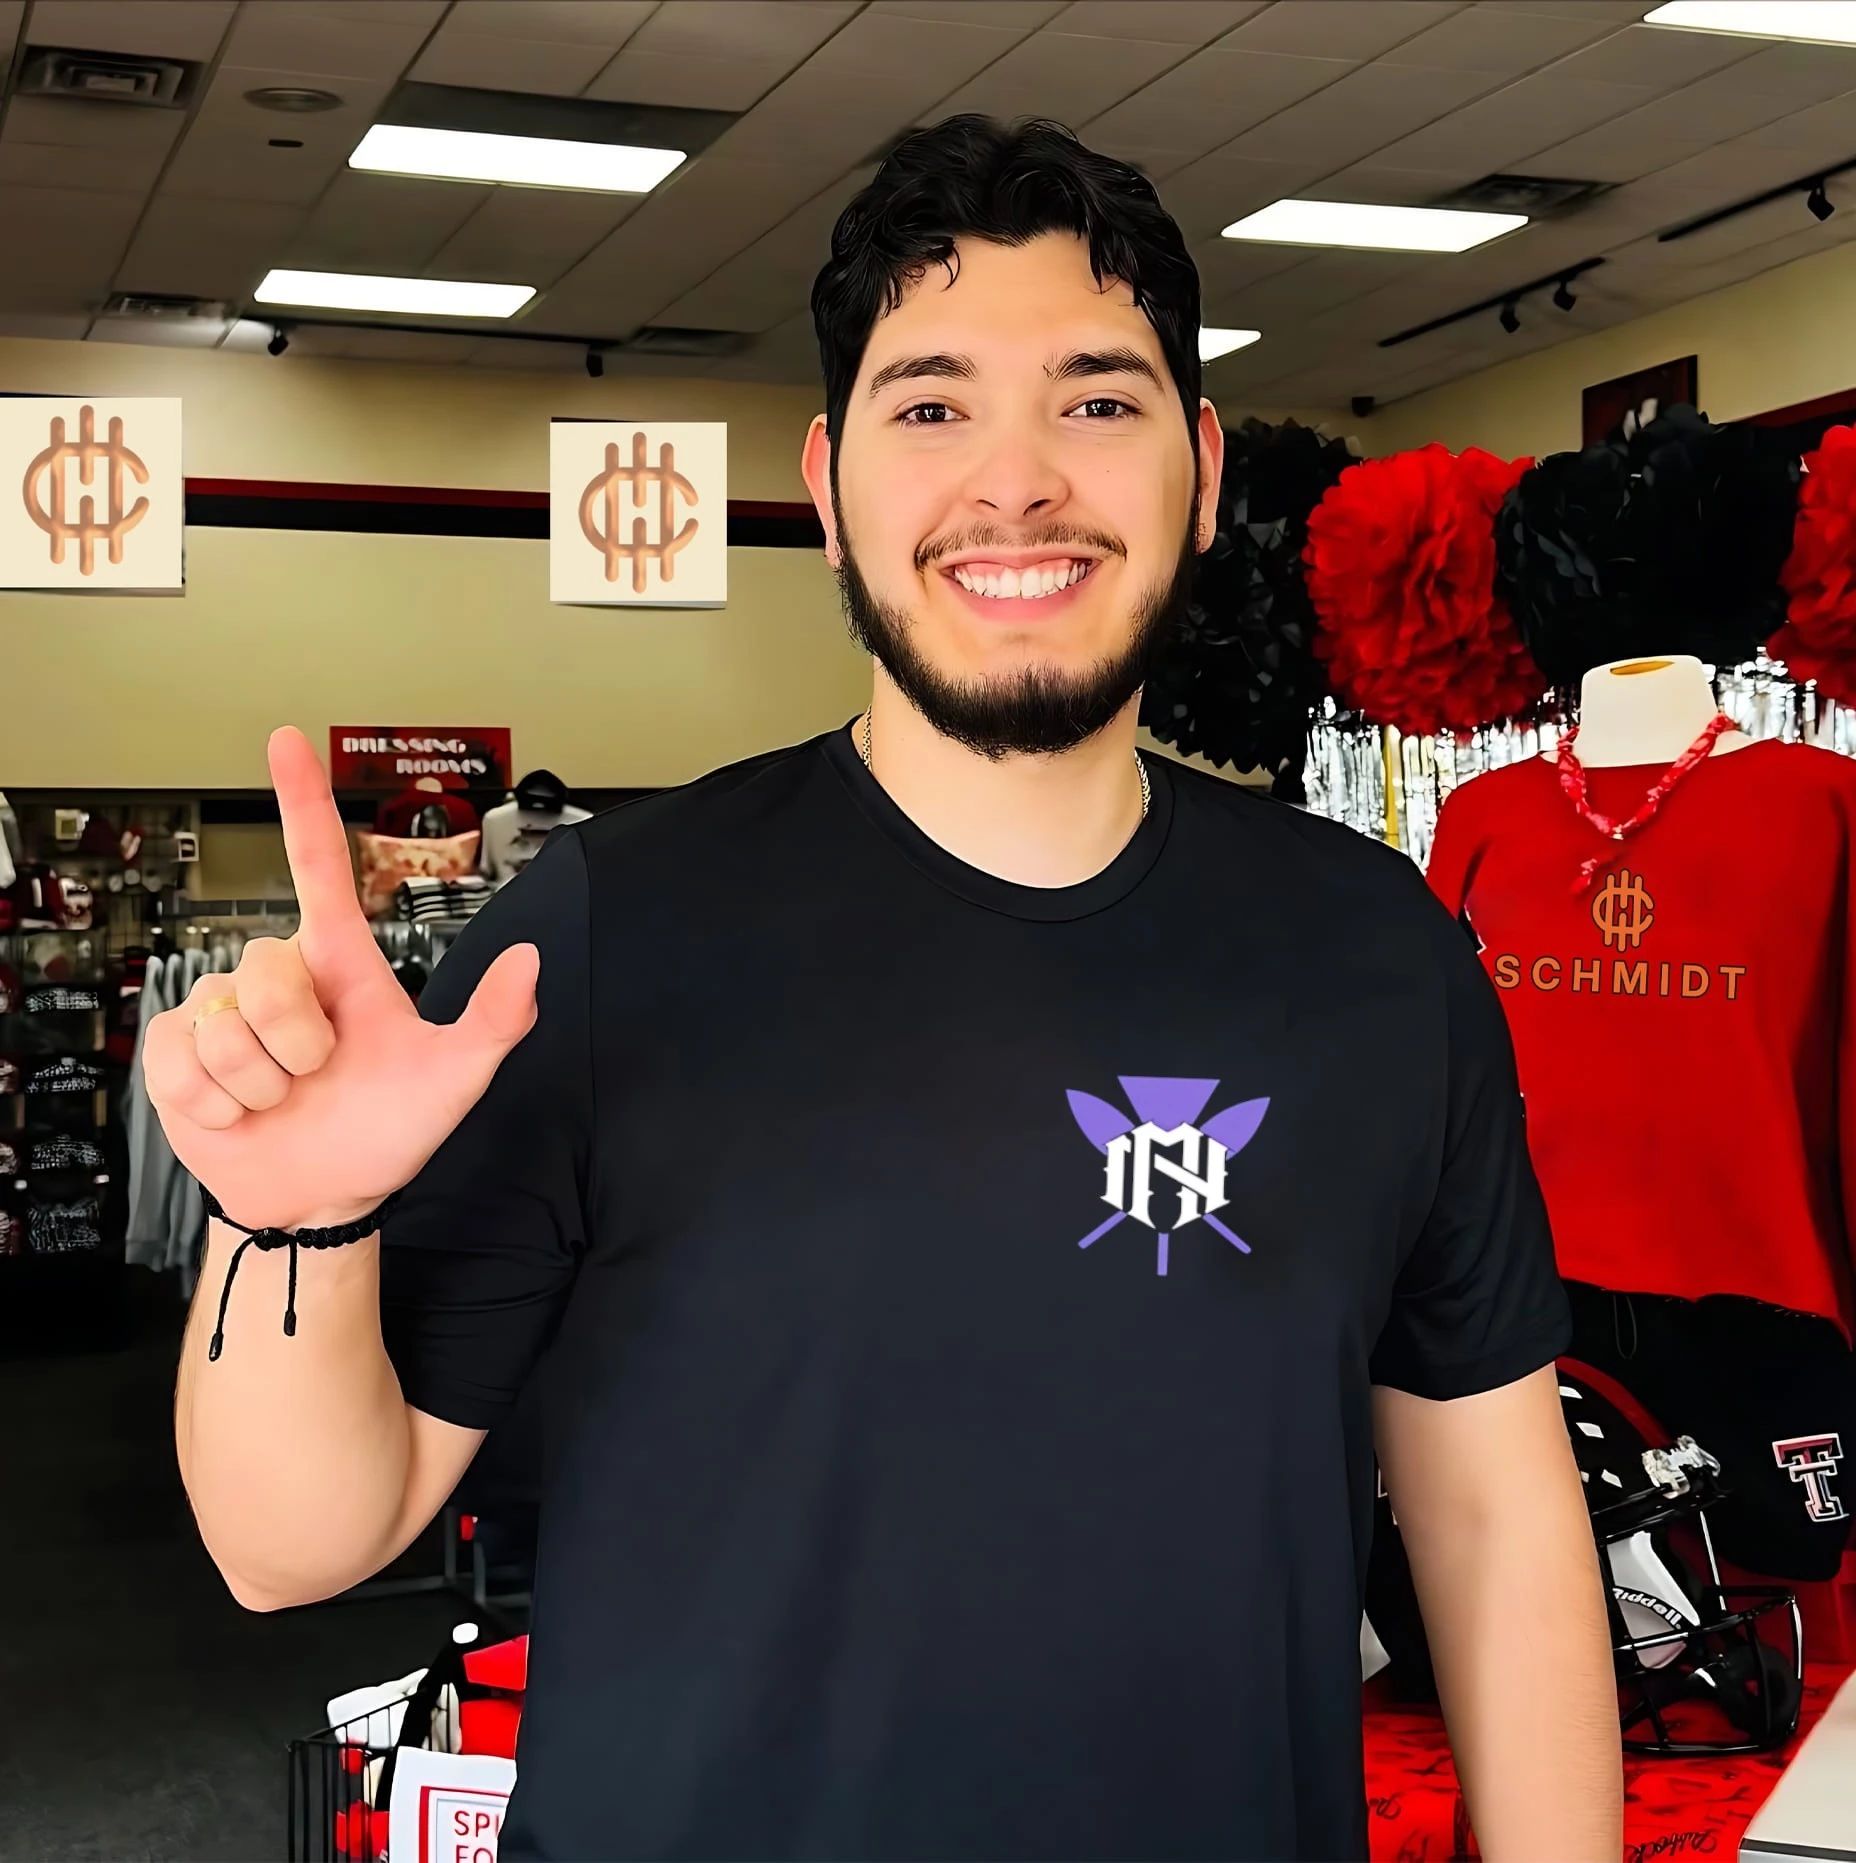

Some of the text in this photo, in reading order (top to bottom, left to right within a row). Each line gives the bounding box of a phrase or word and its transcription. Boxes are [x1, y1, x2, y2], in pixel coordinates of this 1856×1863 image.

[342, 737, 466, 753] DRESSING
[396, 758, 487, 774] ROOMS
[1494, 954, 1746, 1000] SCHMIDT
